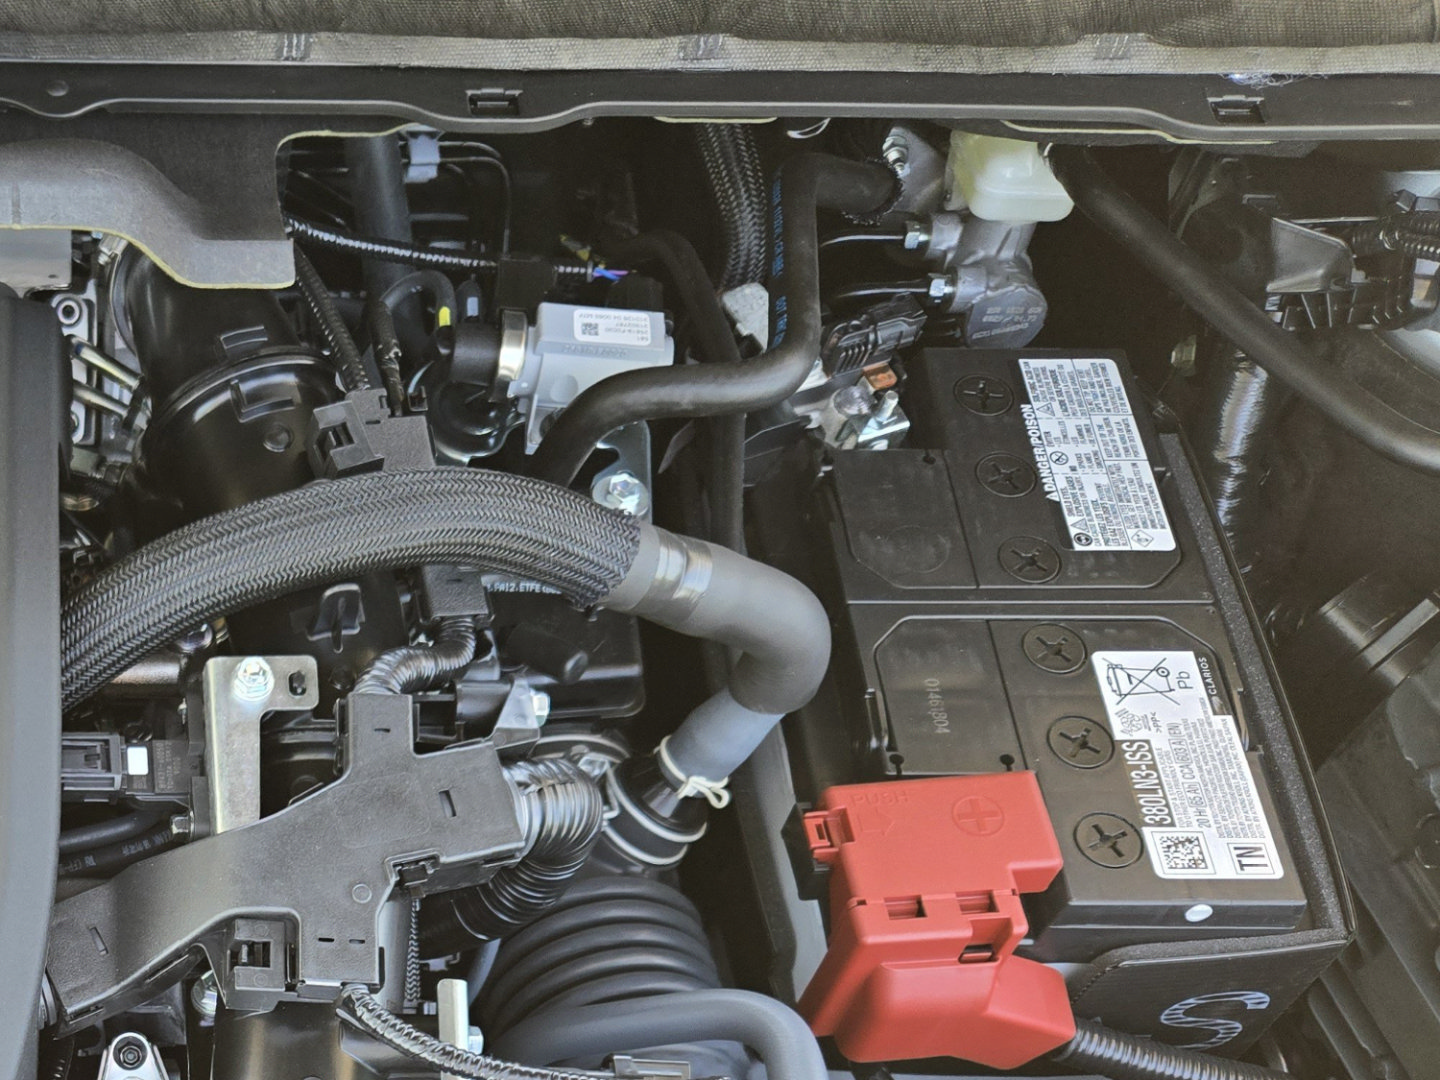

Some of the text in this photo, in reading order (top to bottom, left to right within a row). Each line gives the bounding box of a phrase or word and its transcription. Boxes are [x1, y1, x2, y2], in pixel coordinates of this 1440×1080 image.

[1019, 404, 1057, 492] DANGER/POISON
[1173, 670, 1194, 689] Pb
[1197, 656, 1218, 694] CLARIOS
[850, 790, 908, 806] PUSH
[1120, 741, 1172, 824] 380LN3-ISS
[1232, 846, 1269, 870] TN
